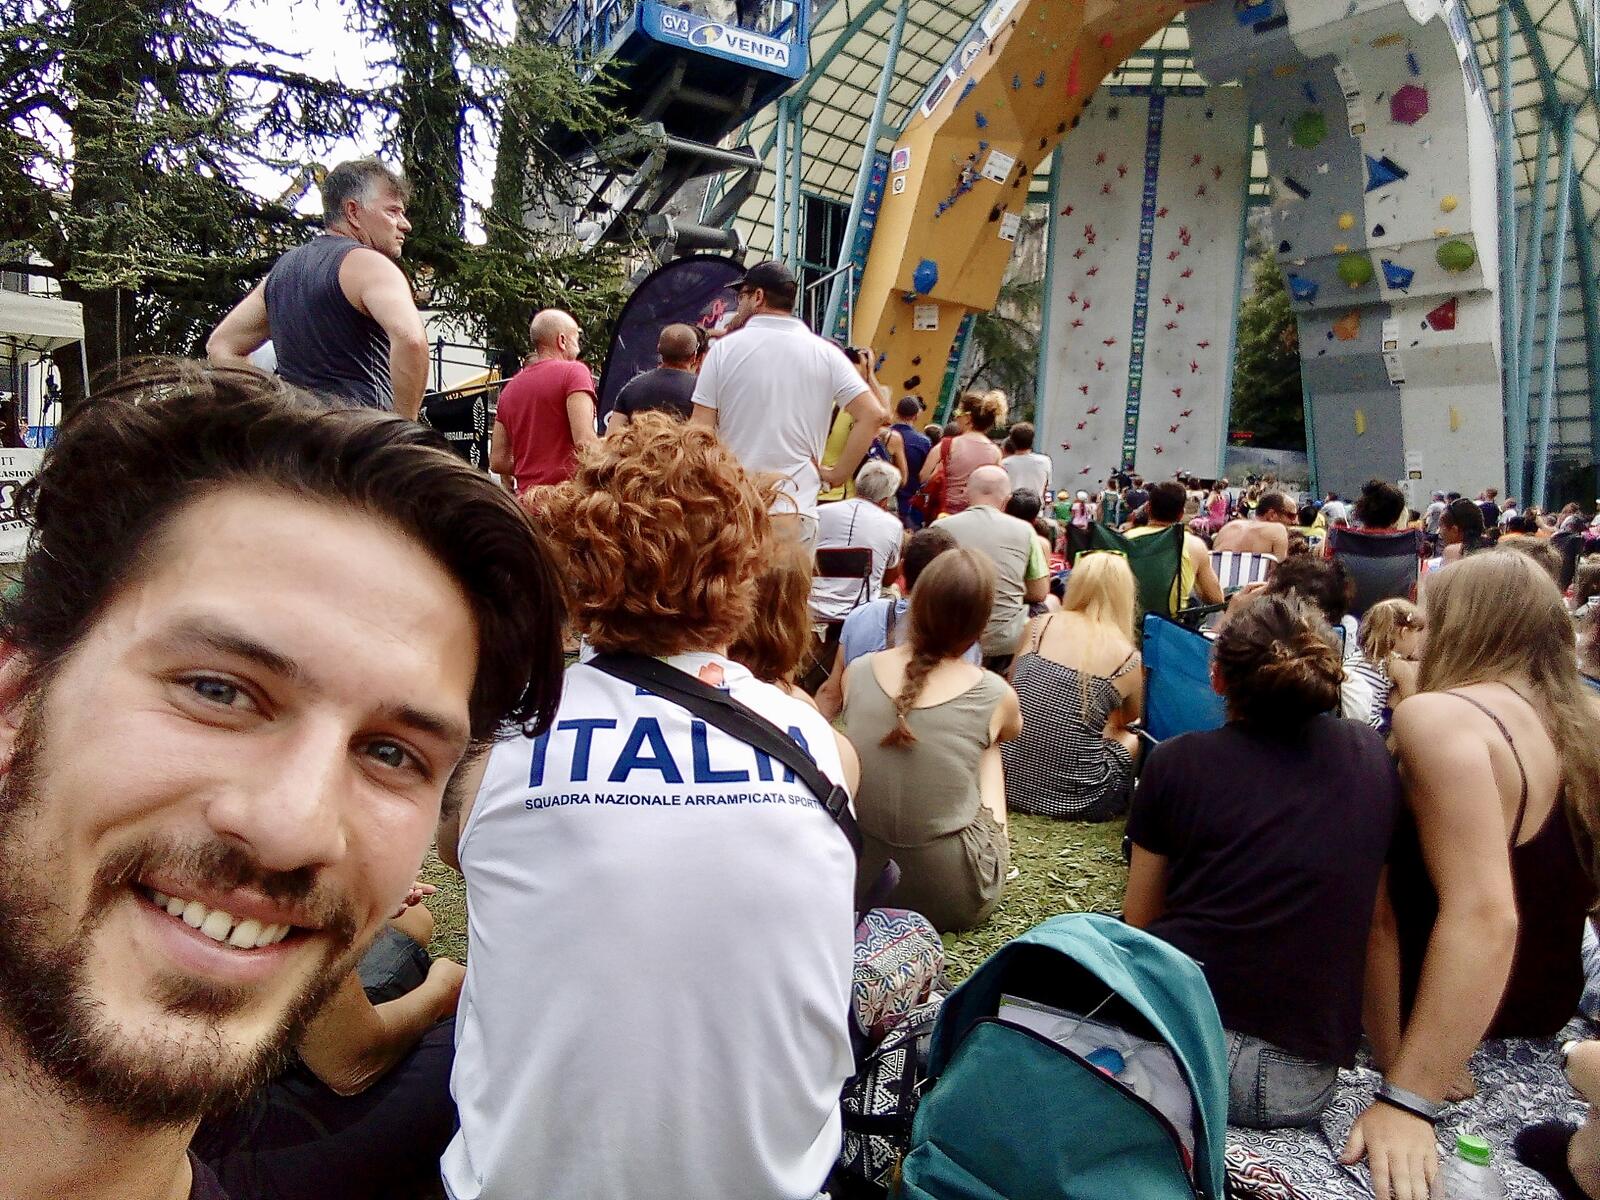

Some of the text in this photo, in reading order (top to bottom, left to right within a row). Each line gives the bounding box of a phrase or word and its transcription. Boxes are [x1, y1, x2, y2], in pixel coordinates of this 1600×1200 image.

[662, 14, 689, 32] GV3
[725, 34, 786, 62] VENPA
[0, 470, 34, 478] ASION
[525, 794, 591, 810] SQUADRA
[594, 793, 681, 806] NAZIONALE
[684, 792, 786, 806] ARRAMPICATA
